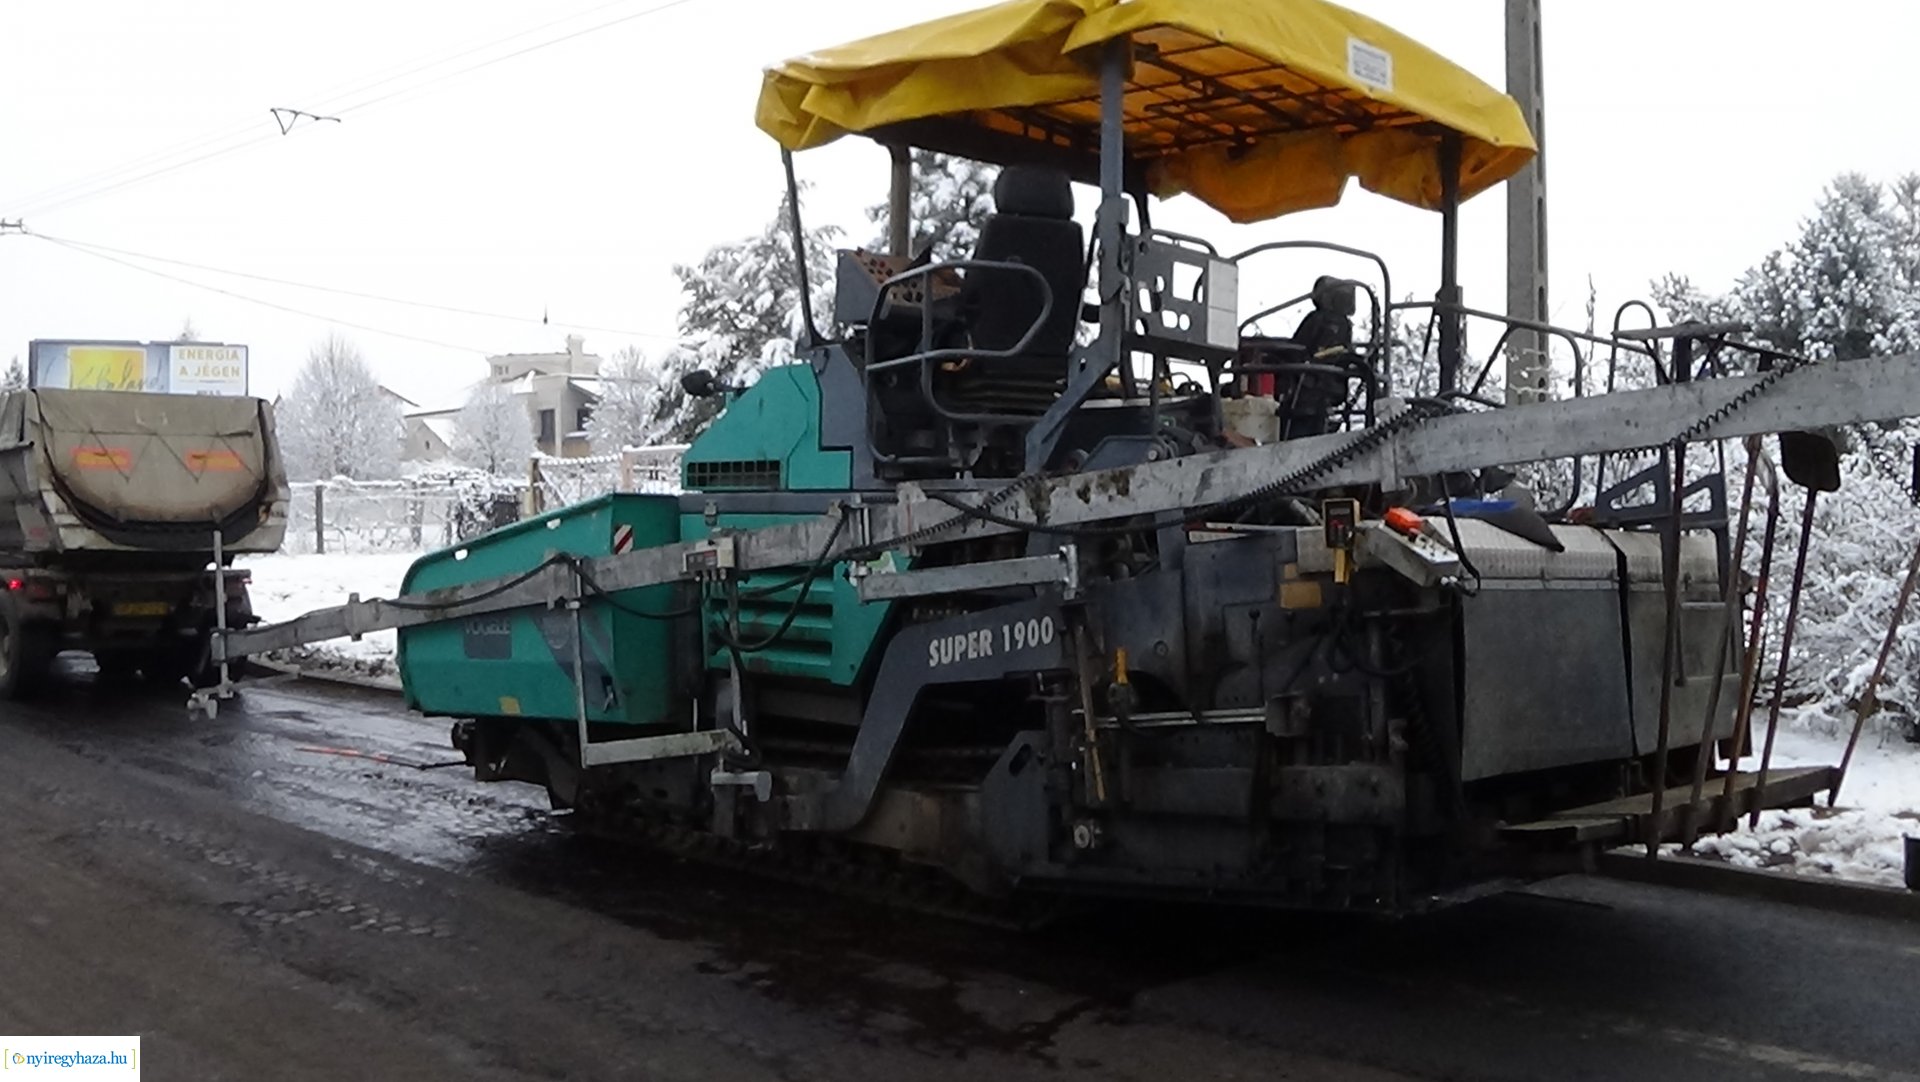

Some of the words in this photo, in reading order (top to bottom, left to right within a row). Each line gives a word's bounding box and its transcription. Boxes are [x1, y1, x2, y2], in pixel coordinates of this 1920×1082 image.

[178, 349, 240, 361] ENERGIA
[179, 365, 189, 377] A
[194, 363, 240, 377] JÉGEN
[929, 629, 993, 667] SUPER
[1002, 616, 1054, 652] 1900
